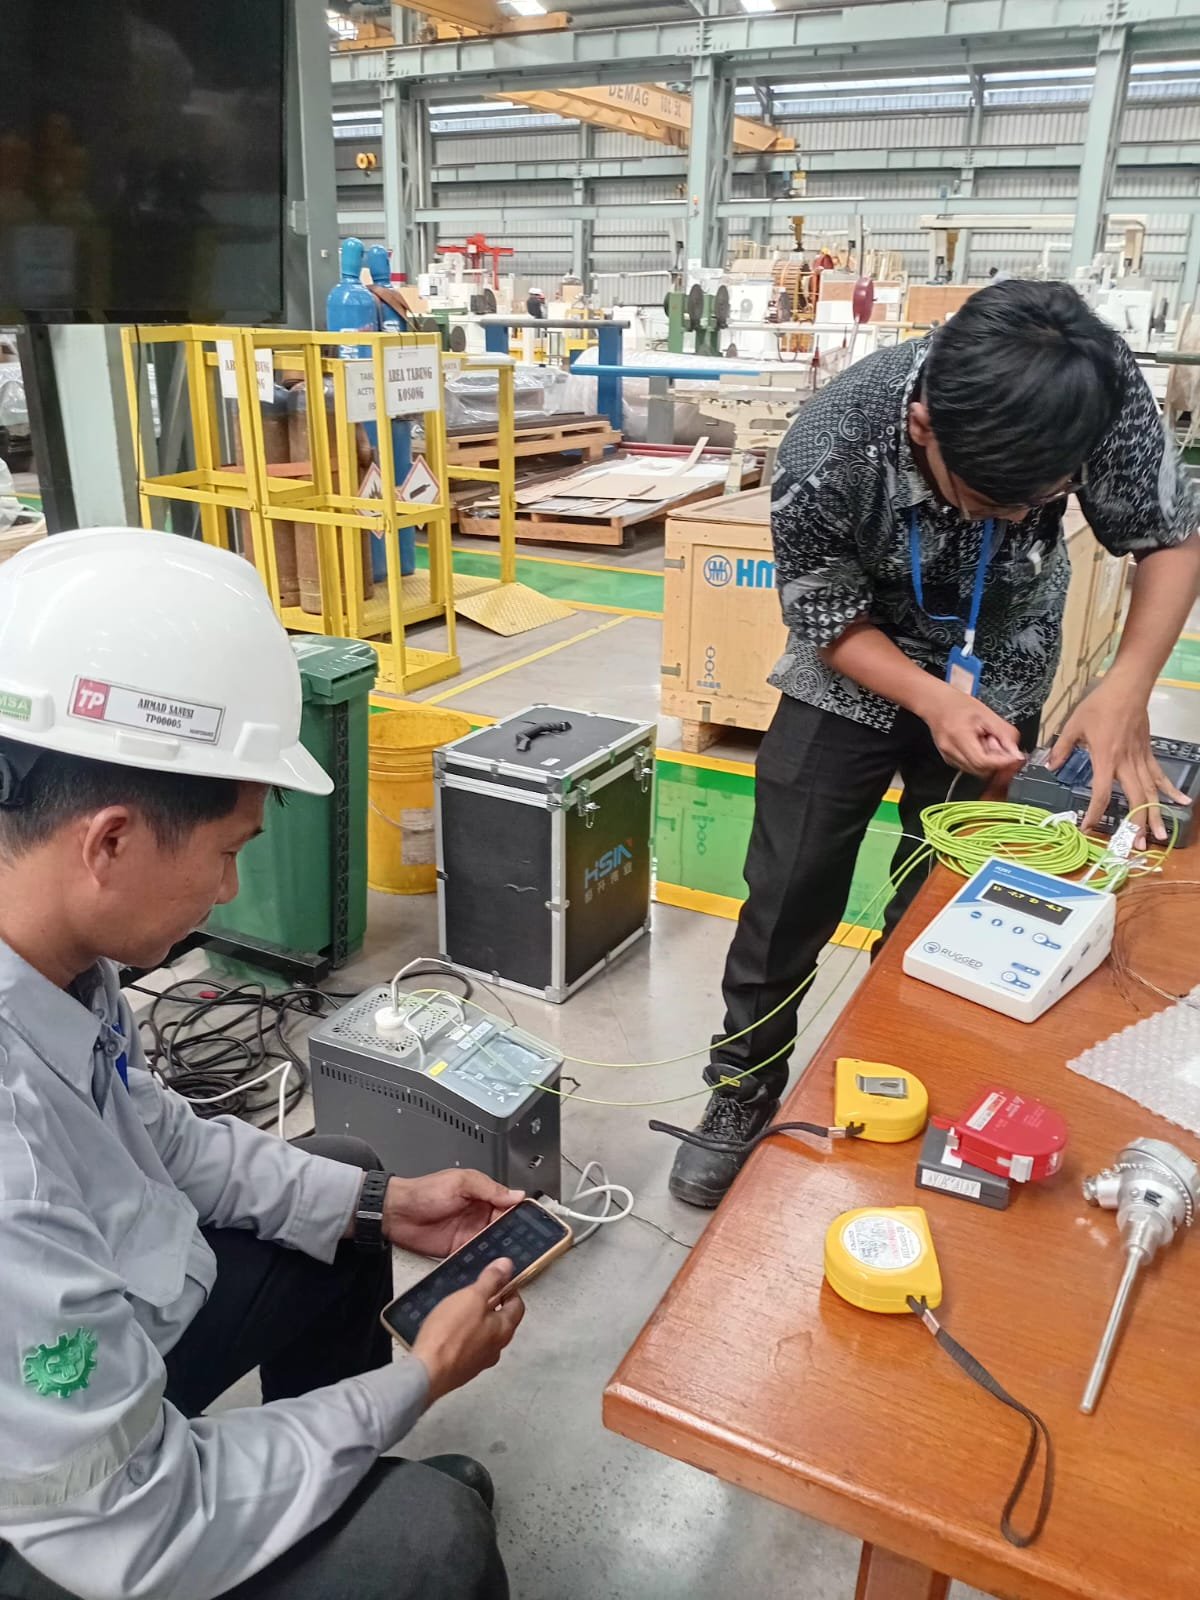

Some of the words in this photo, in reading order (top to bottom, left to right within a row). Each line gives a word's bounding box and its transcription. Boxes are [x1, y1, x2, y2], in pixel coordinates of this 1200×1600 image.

[608, 85, 649, 107] DEMAG
[388, 368, 405, 382] AREA
[406, 366, 433, 381] TABUNG
[397, 386, 424, 402] KOSONG
[78, 688, 105, 710] TP
[137, 698, 167, 714] AHMAD
[145, 713, 182, 729] TP00005
[941, 948, 983, 968] RUGGED
